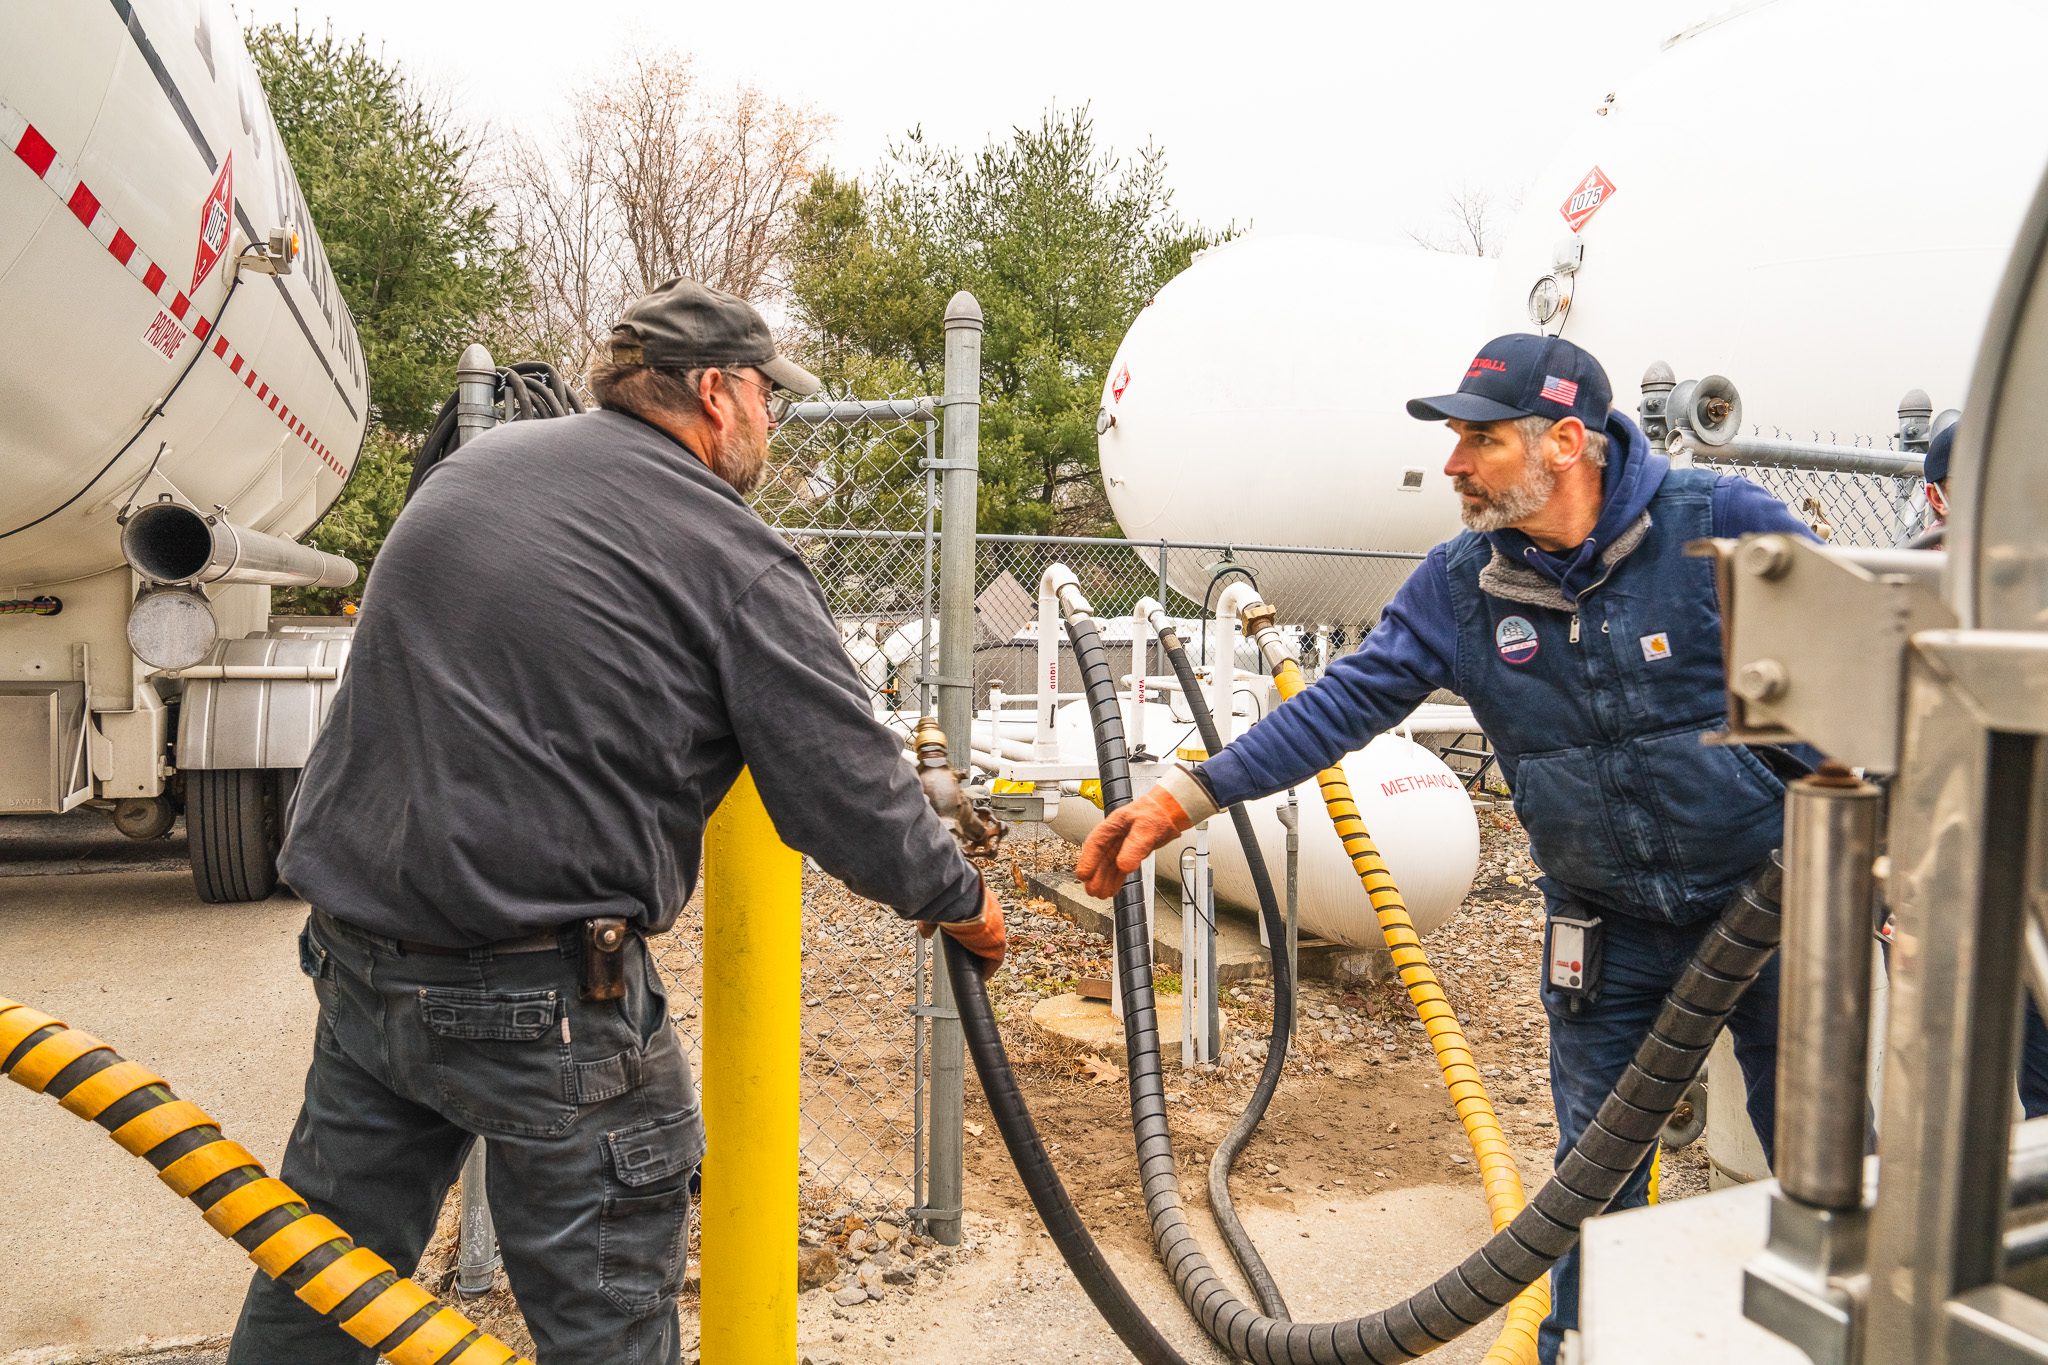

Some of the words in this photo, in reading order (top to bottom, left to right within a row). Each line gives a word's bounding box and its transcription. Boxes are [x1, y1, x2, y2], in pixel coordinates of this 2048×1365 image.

[1571, 187, 1602, 213] 1075
[205, 203, 227, 252] 1075
[198, 259, 207, 277] 2
[143, 310, 187, 359] PROPANE
[1380, 774, 1459, 797] METHANOL
